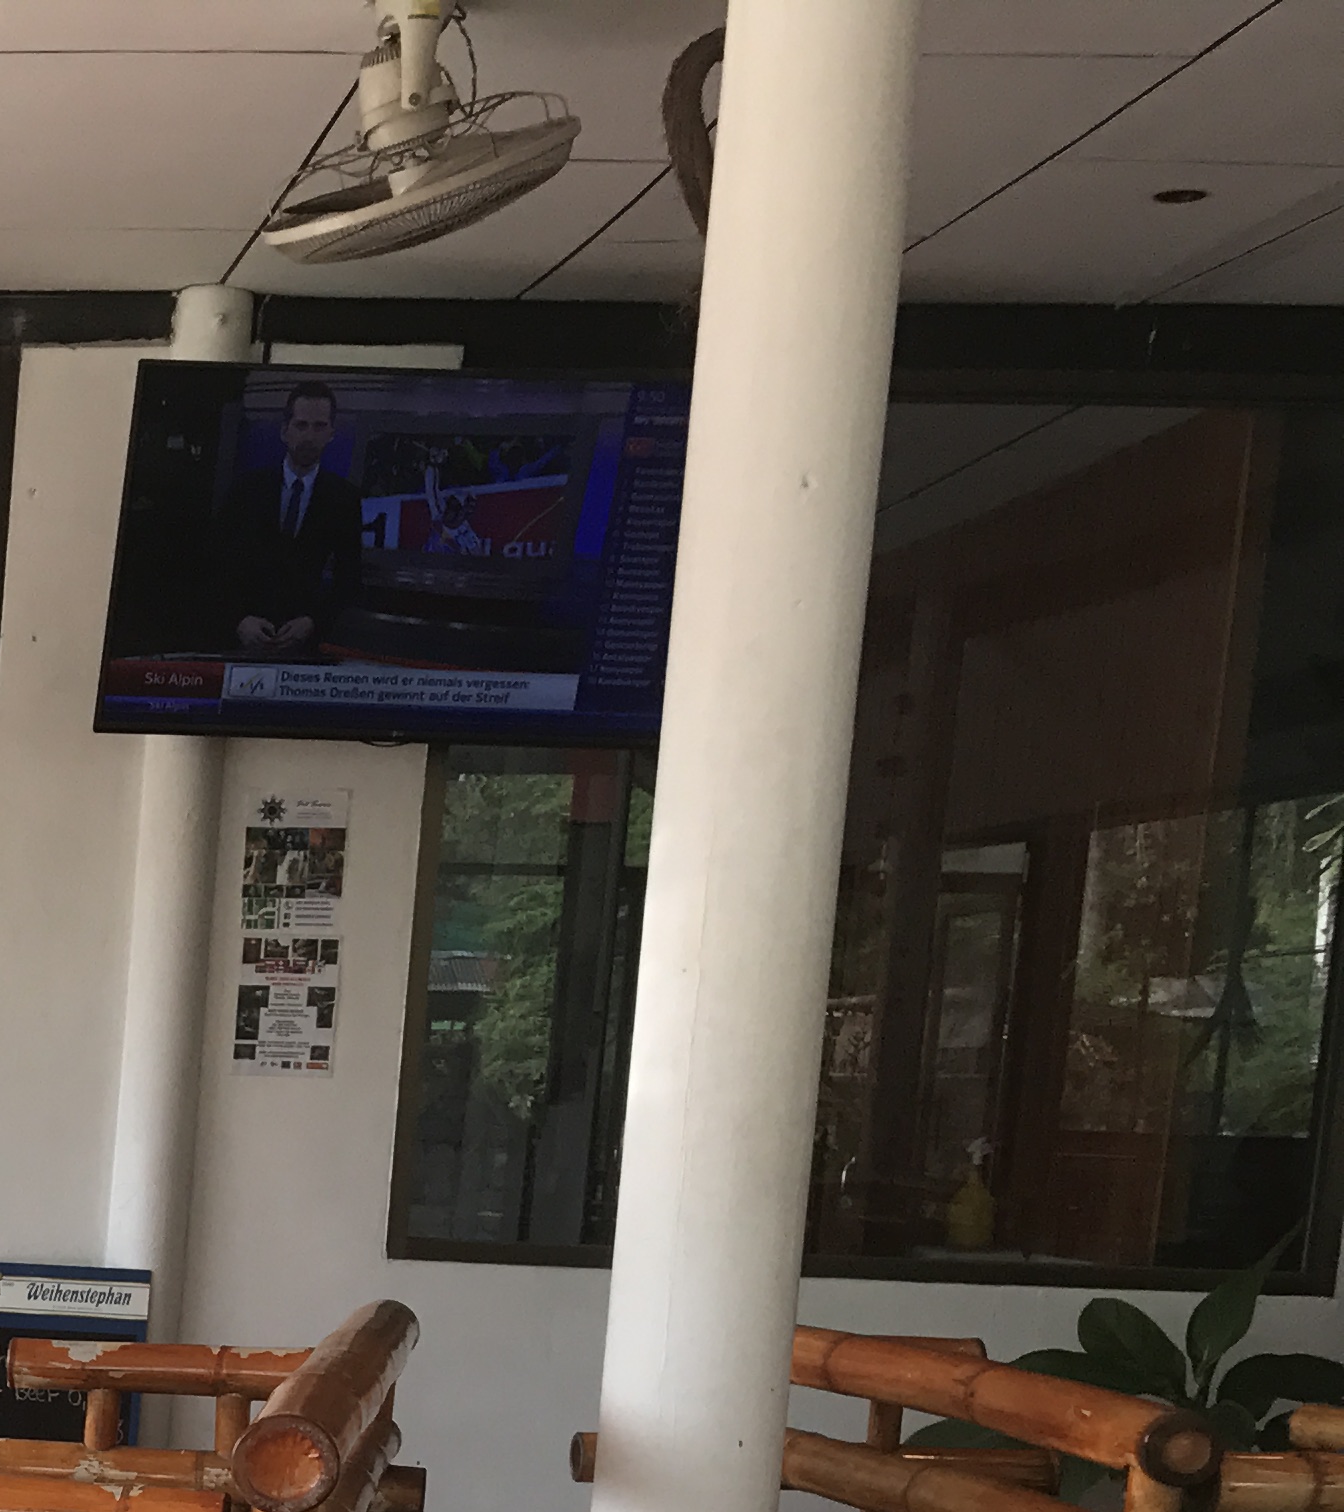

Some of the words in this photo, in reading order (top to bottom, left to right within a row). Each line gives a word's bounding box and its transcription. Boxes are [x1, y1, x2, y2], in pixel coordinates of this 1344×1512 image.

[144, 672, 166, 685] Ski
[168, 672, 204, 687] Alpin
[281, 670, 320, 683] Dieses
[323, 671, 369, 685] Rennen
[372, 674, 398, 686] wird
[401, 677, 414, 687] er
[417, 676, 463, 689] niemals
[279, 685, 327, 698] Thomas
[377, 690, 425, 704] gewinnt
[428, 690, 451, 703] auf
[452, 691, 473, 703] der
[475, 692, 511, 705] Streif
[26, 1282, 132, 1308] Weihenstephan
